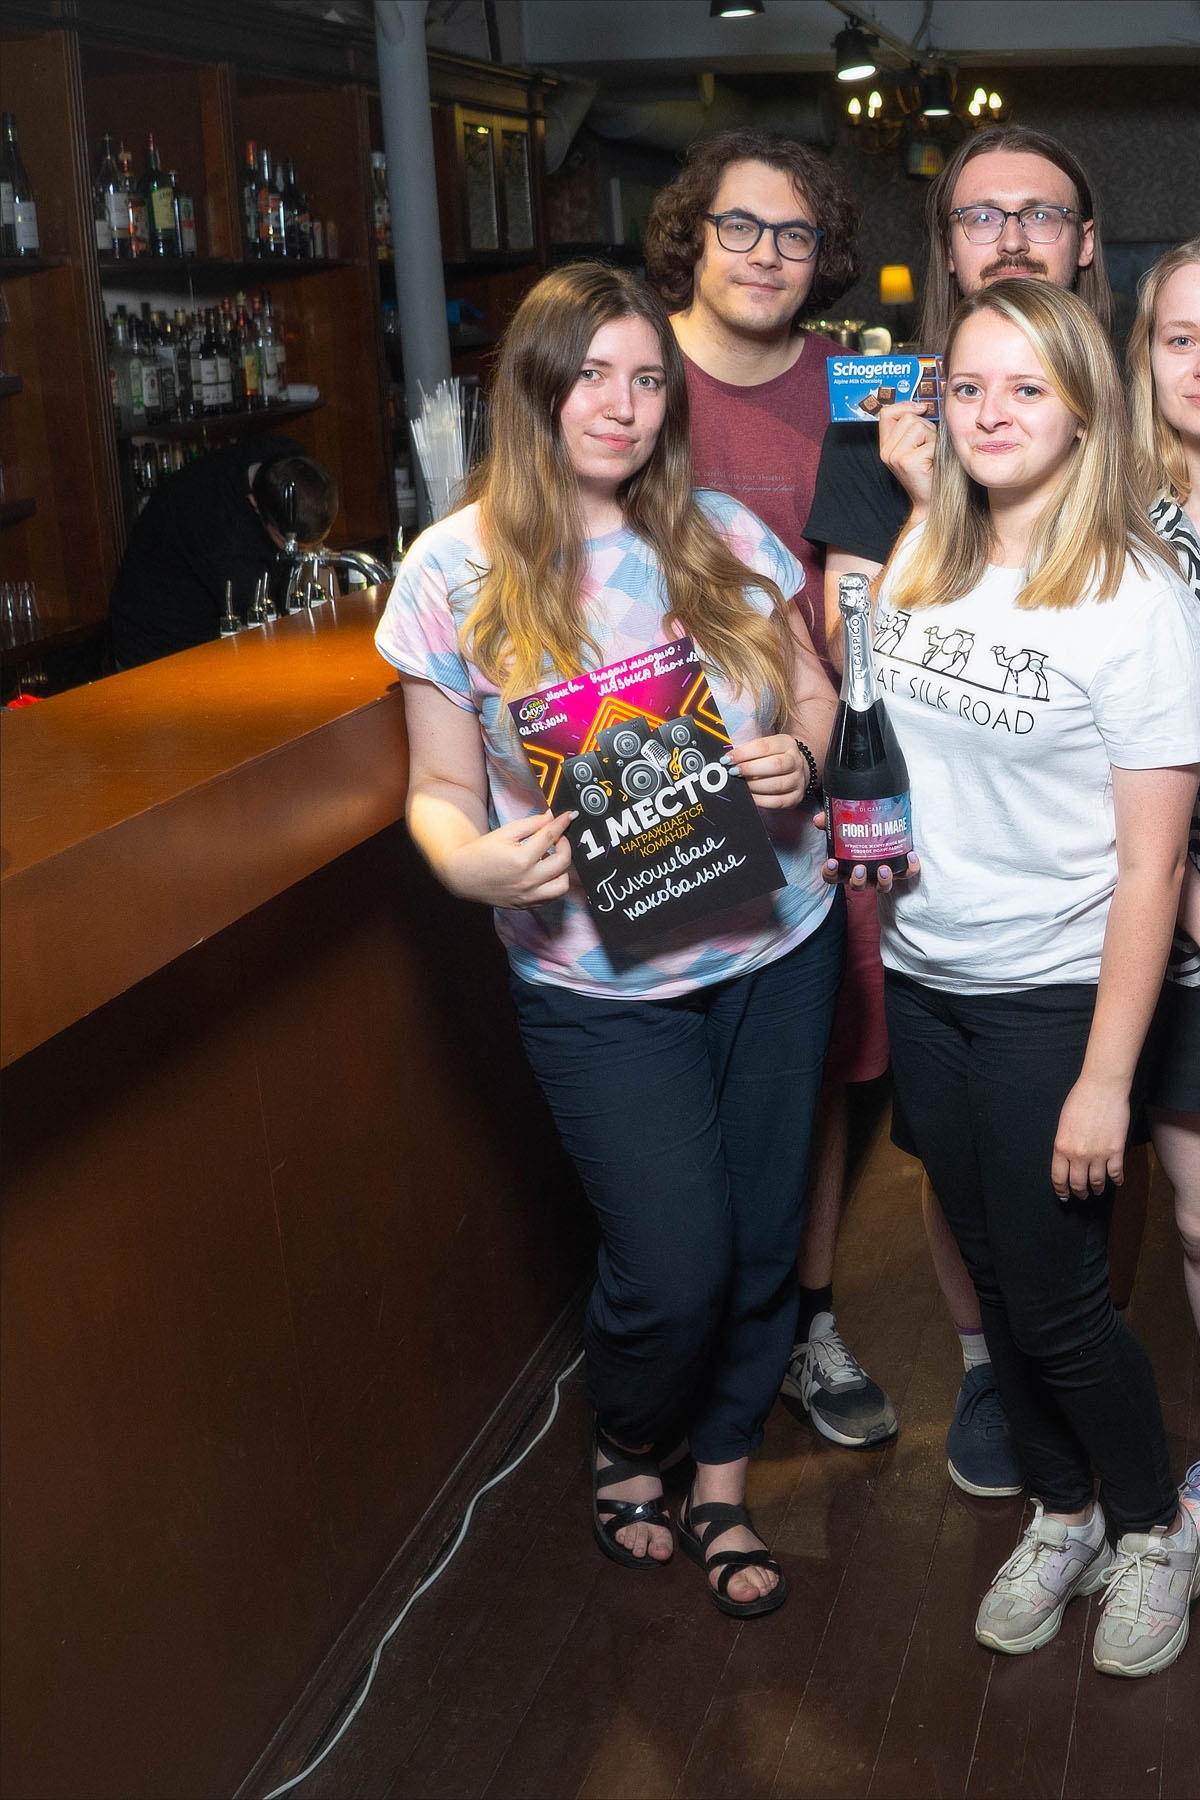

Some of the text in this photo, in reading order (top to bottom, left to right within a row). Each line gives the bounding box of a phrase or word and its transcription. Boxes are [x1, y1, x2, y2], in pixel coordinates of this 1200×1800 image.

[833, 361, 911, 378] Schogetten
[851, 618, 862, 666] CASPICO
[519, 702, 550, 721] Смузи
[909, 676, 949, 710] SILK
[959, 694, 1035, 735] ROAD
[579, 762, 729, 861] 1 МЕСТО
[620, 803, 706, 855] НАГРАЖДАЕТСЯ
[842, 817, 907, 838] FIORI DI MARE
[639, 823, 696, 858] КОМАНДА
[596, 836, 727, 912] Плюшевая
[623, 854, 747, 921] наковальня
